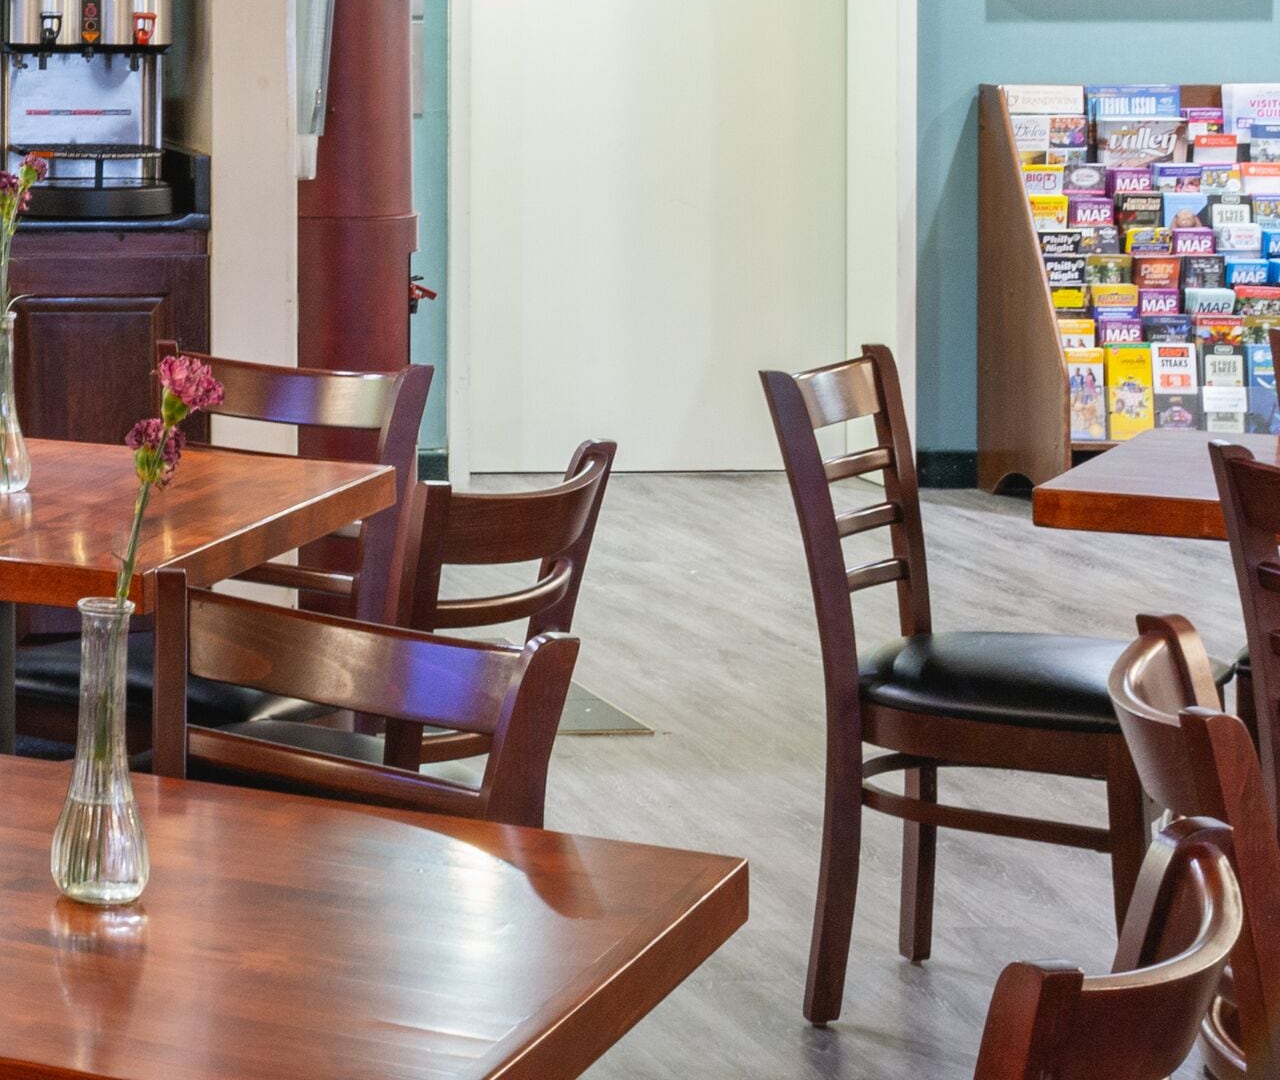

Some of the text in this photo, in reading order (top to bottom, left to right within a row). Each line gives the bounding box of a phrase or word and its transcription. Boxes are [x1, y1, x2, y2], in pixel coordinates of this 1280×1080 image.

[1249, 99, 1280, 108] VISIT
[1256, 109, 1280, 118] GUI
[1109, 127, 1178, 156] valley
[1116, 178, 1150, 191] MAP
[1076, 209, 1111, 222] MAP
[1043, 234, 1073, 245] Philly
[1045, 243, 1075, 253] Night
[1177, 240, 1212, 252] MAP
[1046, 260, 1077, 271] Philly
[1141, 264, 1174, 277] parx
[1050, 271, 1080, 281] Night
[1231, 271, 1266, 284] MAP
[1142, 299, 1177, 312] MAP
[1198, 302, 1231, 313] MAP
[1106, 329, 1140, 342] MAP
[1160, 359, 1188, 368] STEAKS
